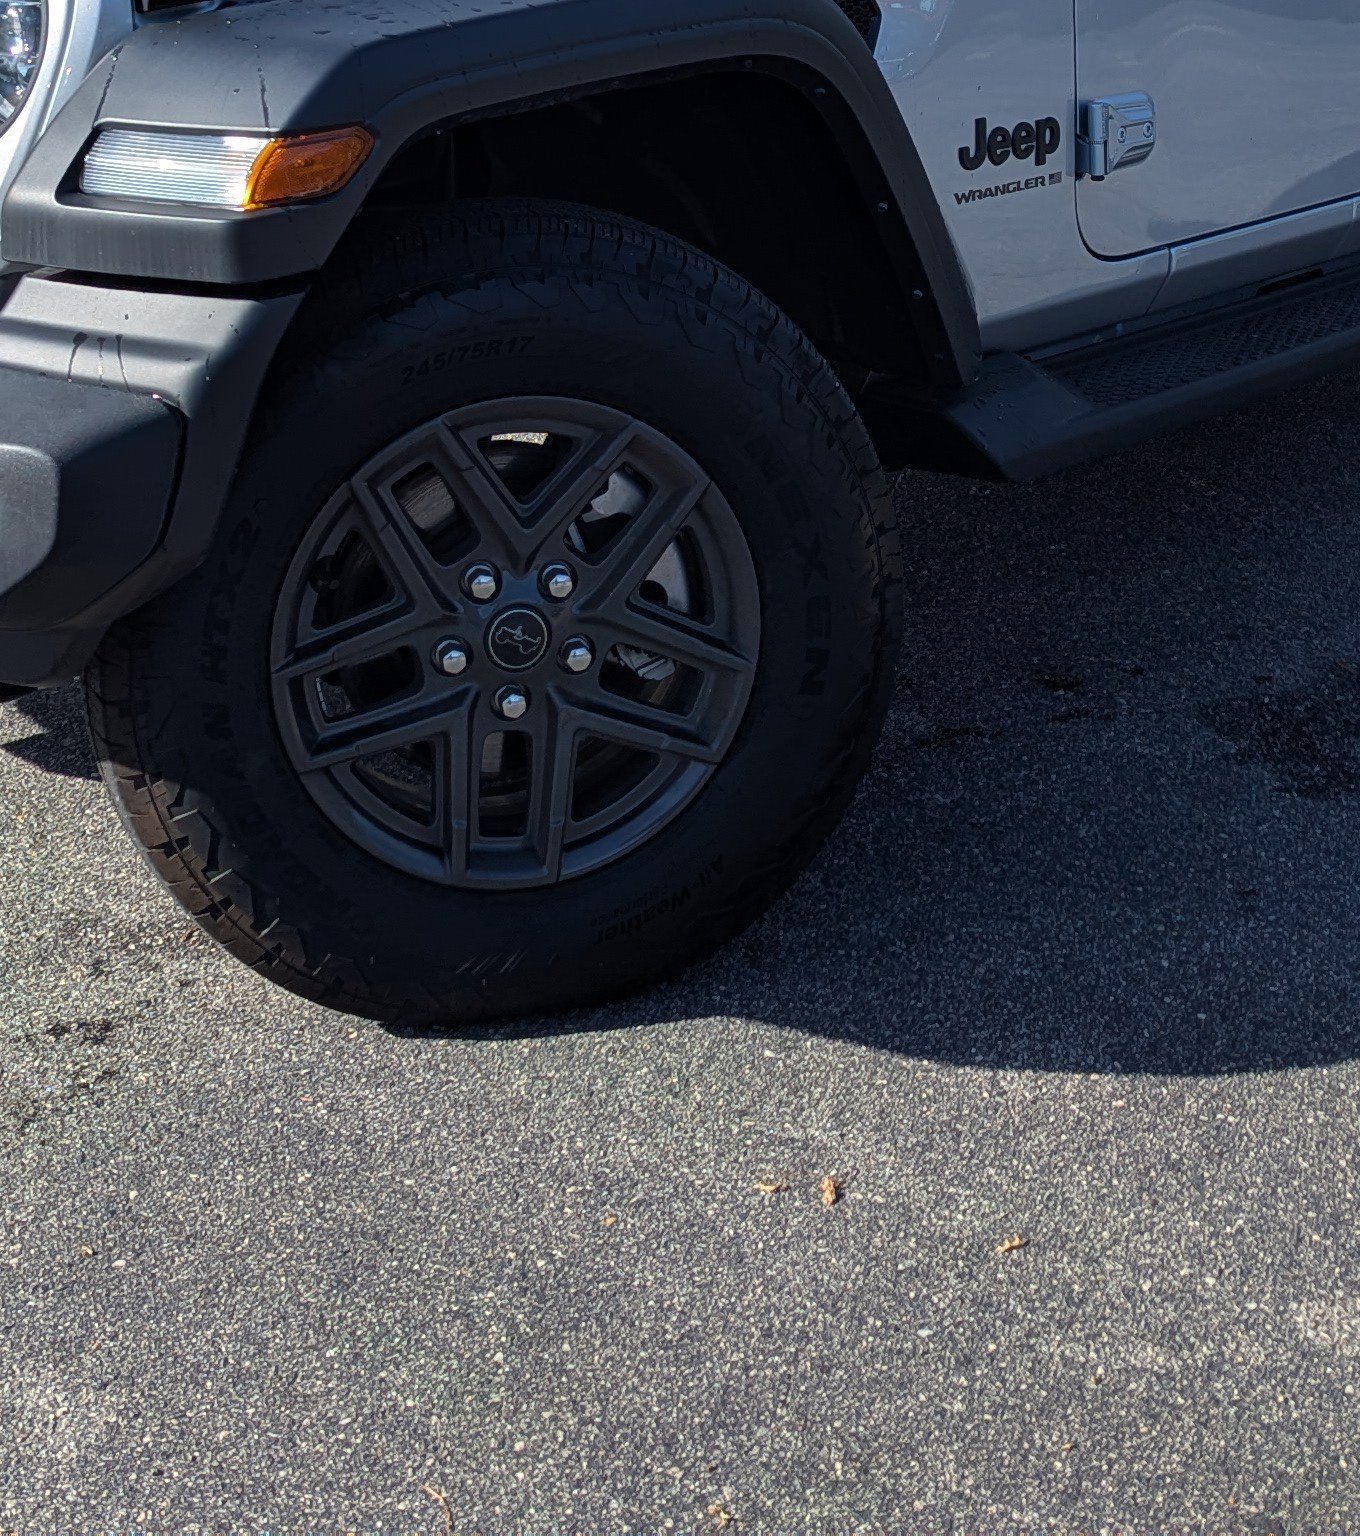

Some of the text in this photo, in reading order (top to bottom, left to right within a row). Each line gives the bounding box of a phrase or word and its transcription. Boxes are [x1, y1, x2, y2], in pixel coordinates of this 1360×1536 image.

[957, 116, 1061, 171] Jeep
[953, 175, 1046, 206] WRANGLER
[400, 335, 536, 387] 245/75R17
[744, 433, 832, 697] NEXEN
